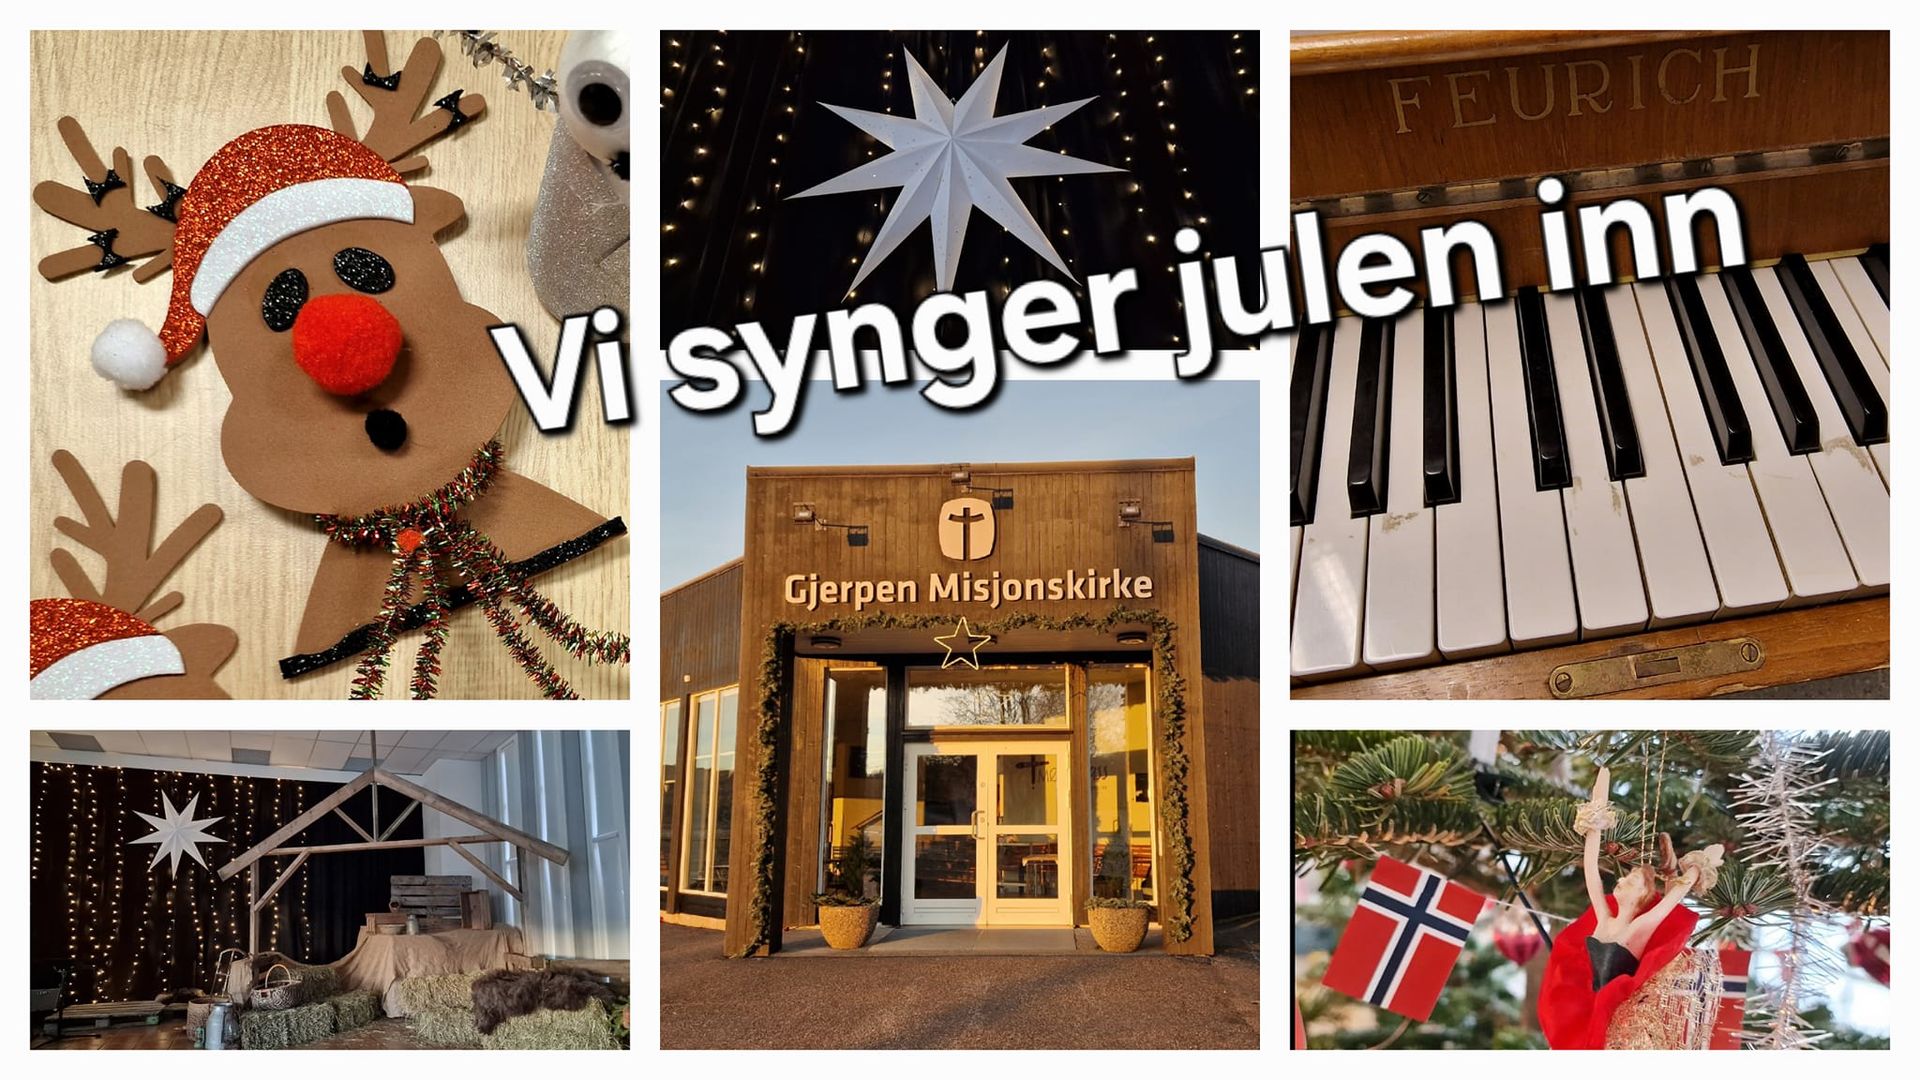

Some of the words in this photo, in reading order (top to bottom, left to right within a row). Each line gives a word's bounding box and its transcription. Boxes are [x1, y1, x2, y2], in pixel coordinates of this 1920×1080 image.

[1387, 44, 1761, 134] FEURICH
[785, 574, 917, 610] Gjerpen
[929, 568, 1153, 609] Misjonskirke
